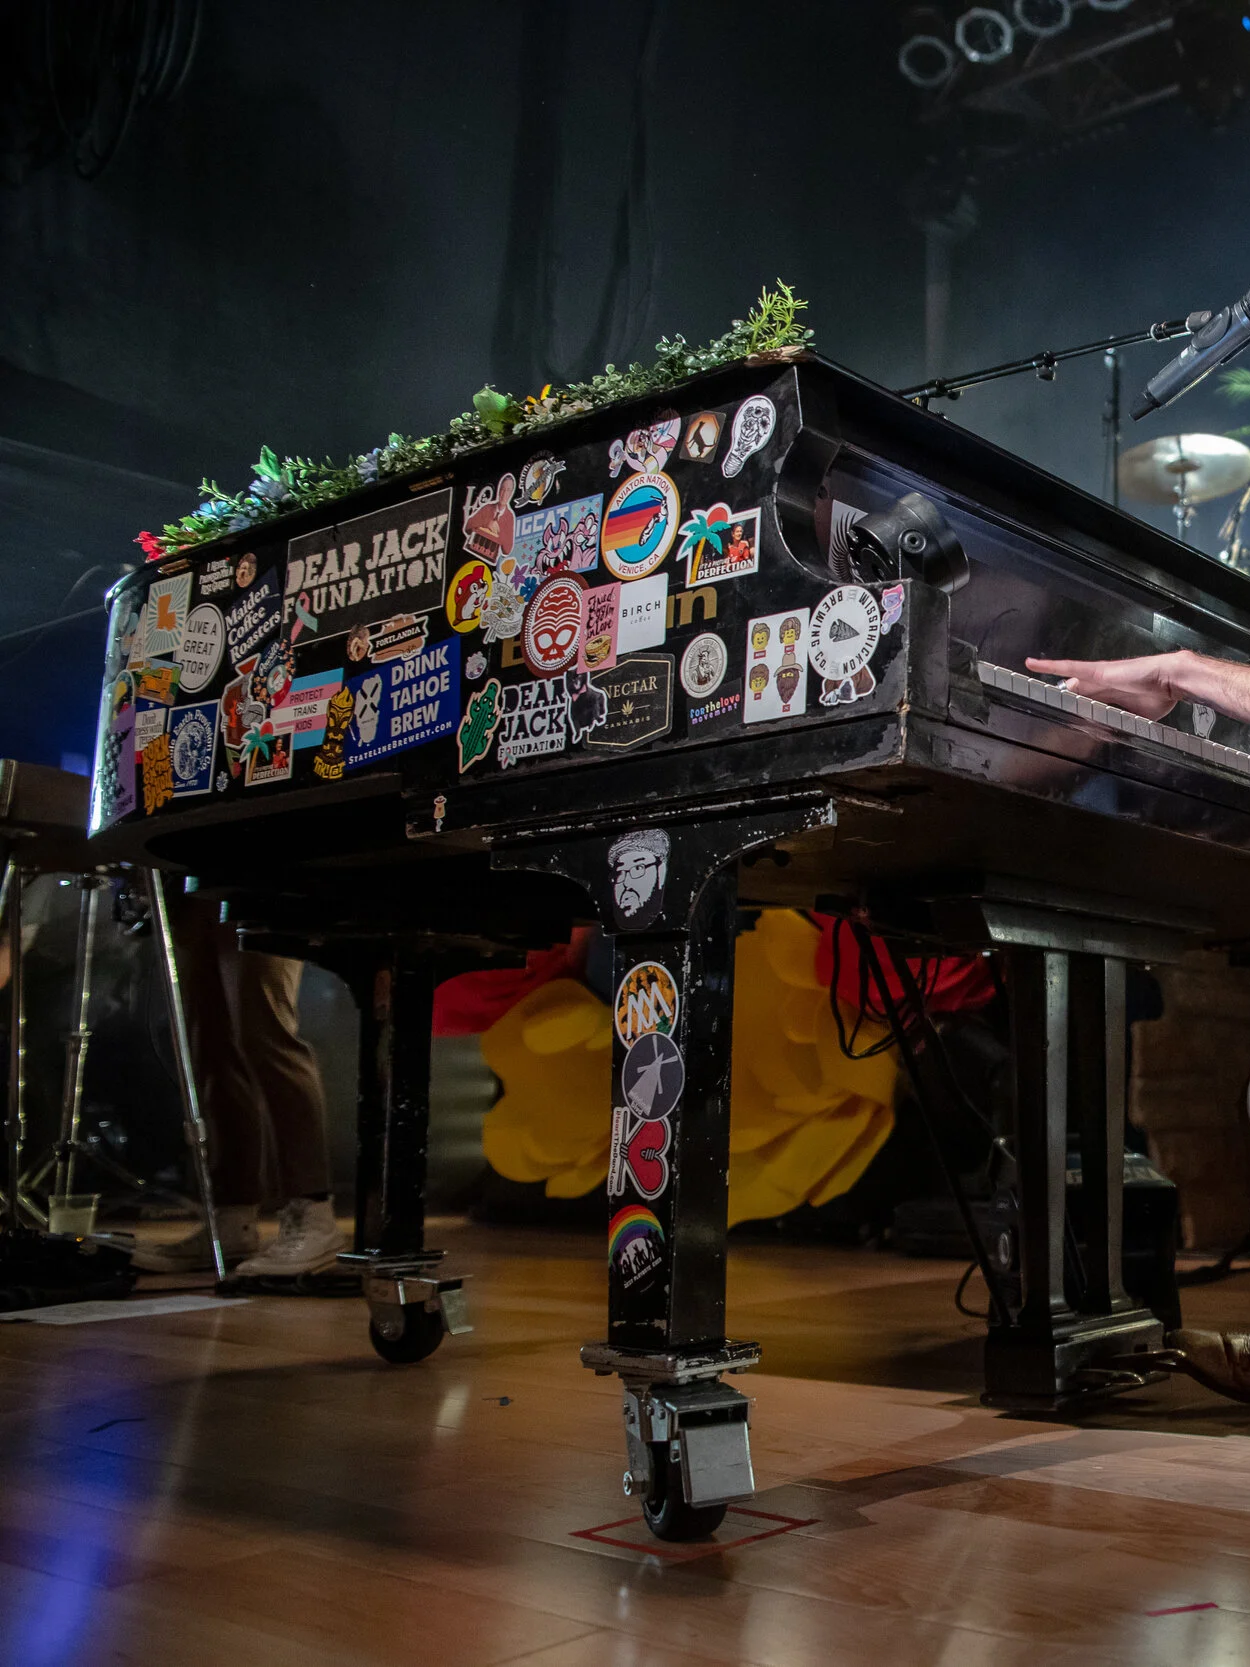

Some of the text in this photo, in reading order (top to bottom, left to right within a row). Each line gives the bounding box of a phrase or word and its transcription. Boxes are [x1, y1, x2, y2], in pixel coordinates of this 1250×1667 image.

[616, 474, 671, 507] AVIATOR NATION
[515, 506, 570, 538] IGCAT
[285, 541, 361, 595] DEAR
[365, 513, 448, 571] JACK
[648, 553, 660, 566] CA
[697, 559, 754, 580] PERFECTION
[282, 552, 444, 624] FOUNDATION
[225, 584, 270, 631] Maiden
[621, 600, 661, 618] BIRCH
[811, 590, 843, 648] BREWING
[187, 620, 217, 636] LIVE A
[228, 606, 266, 646] Coffee
[230, 611, 281, 664] Roasters
[842, 591, 879, 675] WISSAHICKON
[183, 639, 215, 656] GREAT
[180, 659, 210, 676] STORY
[390, 645, 449, 687] DRINK
[289, 688, 324, 704] PROTECT
[390, 670, 450, 712] TAHOE
[503, 678, 565, 715] DEAR
[602, 676, 658, 700] NECTAR
[293, 704, 318, 719] TRANS
[295, 719, 313, 732] KIDS
[390, 700, 440, 738] BREW
[501, 706, 565, 744] JACK
[604, 715, 651, 729] CANNABIS
[499, 738, 564, 757] FOUNDATION
